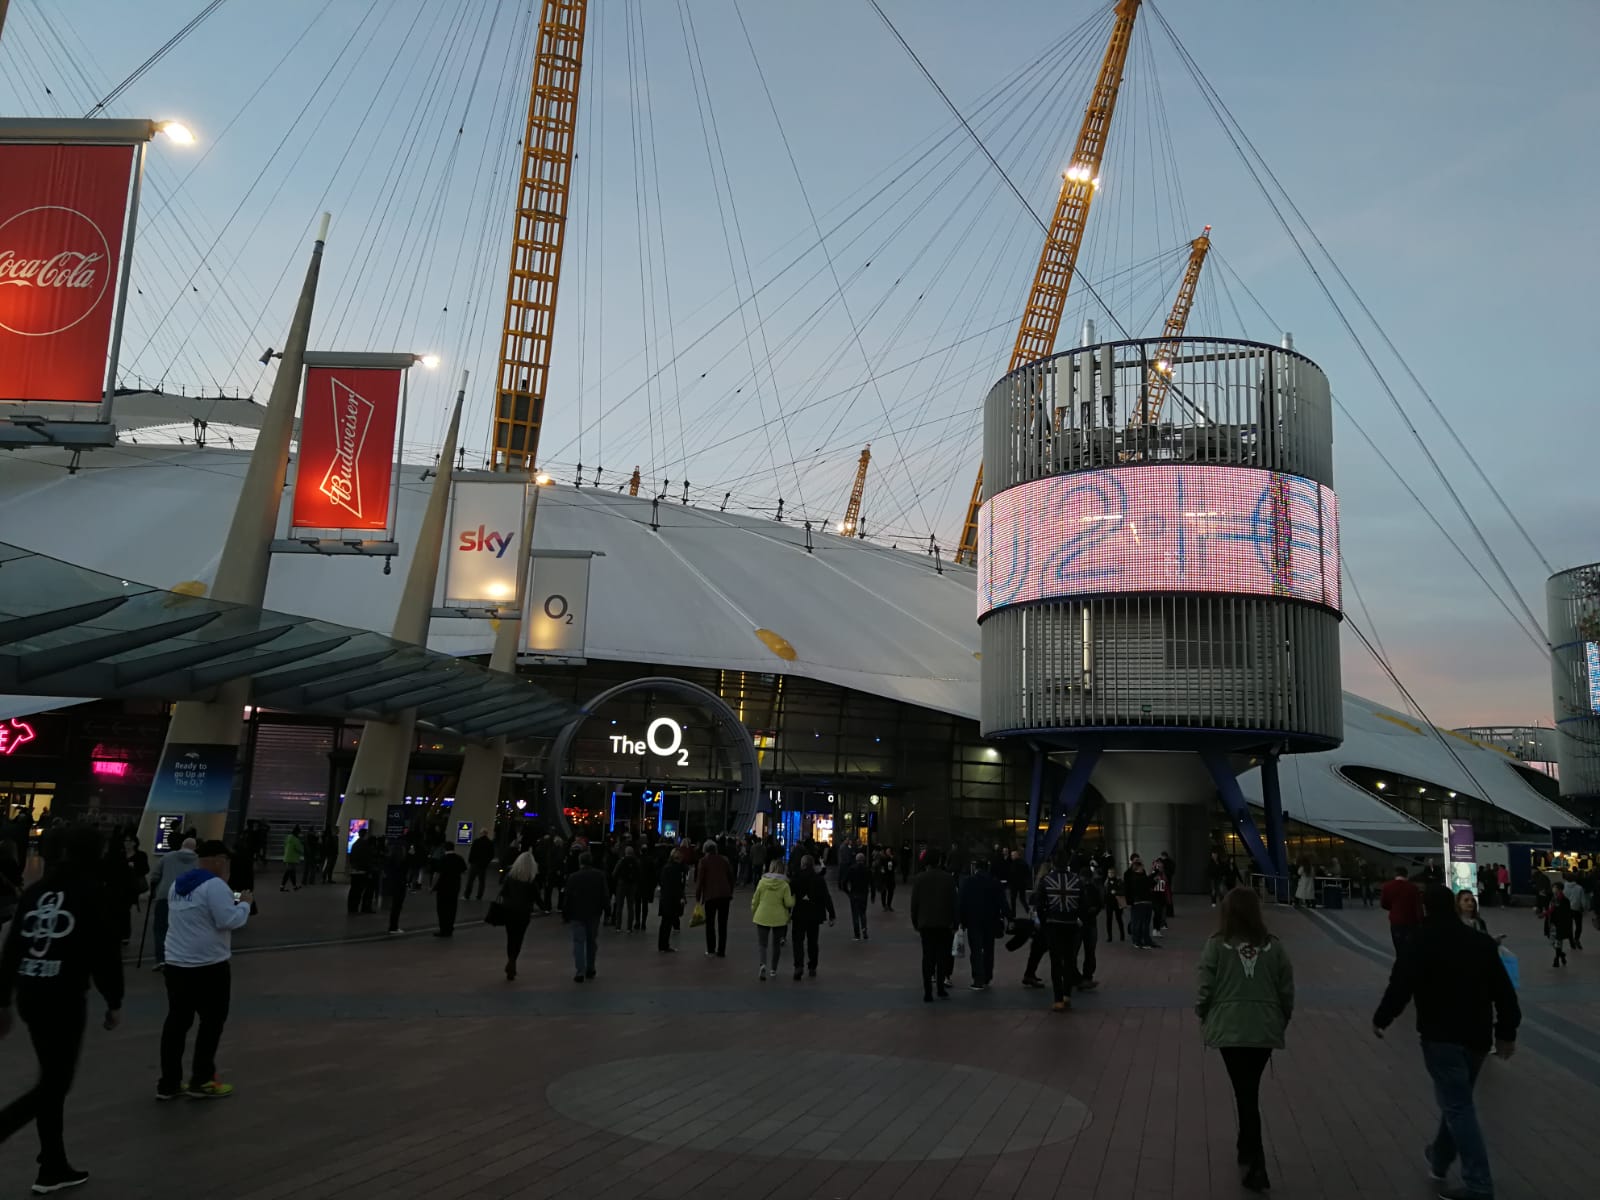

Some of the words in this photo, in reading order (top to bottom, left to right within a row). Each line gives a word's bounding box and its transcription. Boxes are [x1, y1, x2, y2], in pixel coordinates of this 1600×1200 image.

[330, 392, 359, 505] Budweiser
[459, 524, 515, 559] sky
[544, 594, 574, 625] O2
[608, 734, 647, 756] The
[646, 717, 689, 766] O2
[174, 771, 184, 779] go
[185, 770, 196, 779] Up
[175, 761, 197, 771] Ready
[175, 778, 188, 786] The
